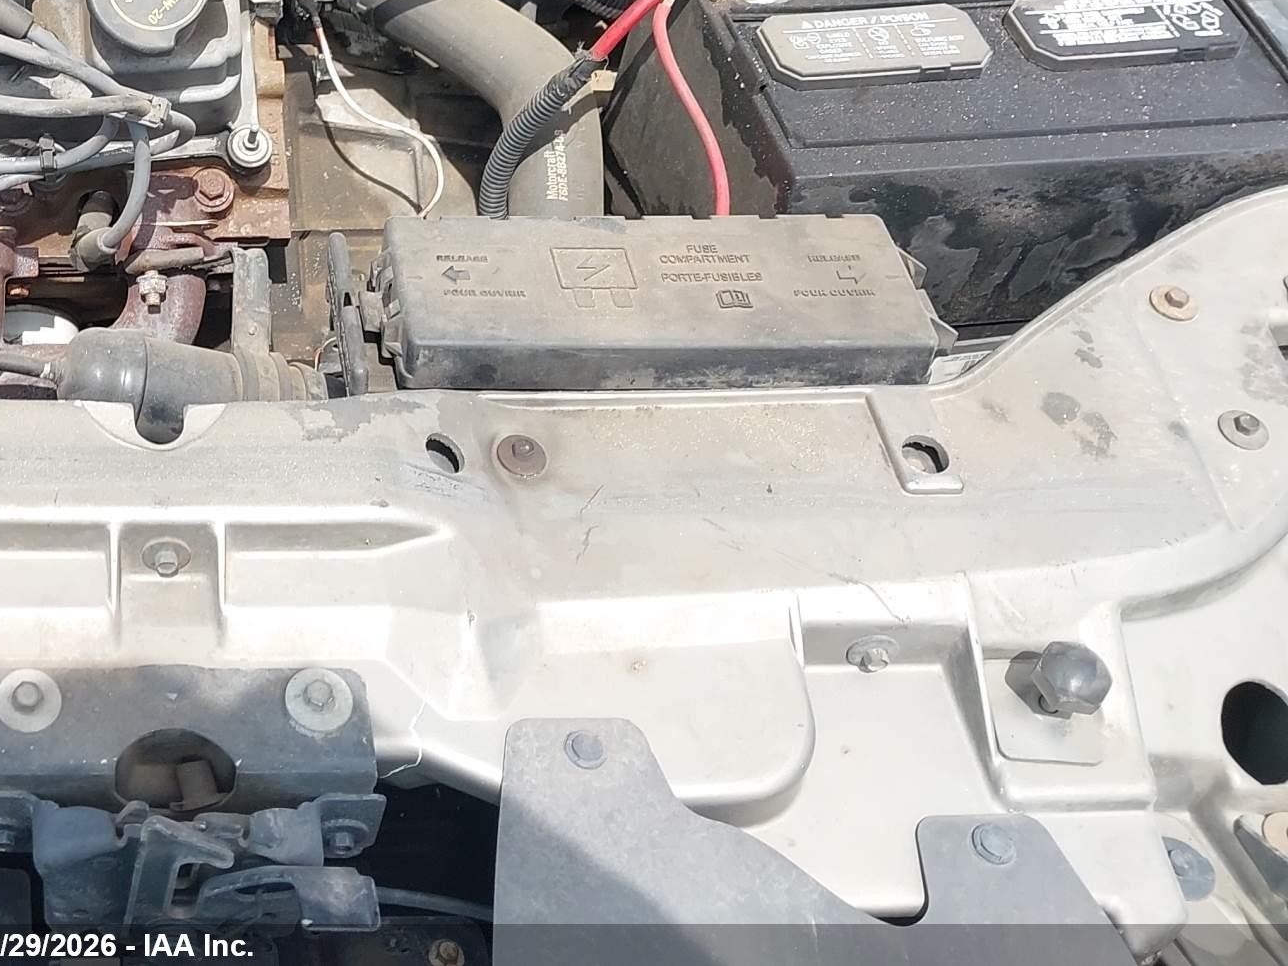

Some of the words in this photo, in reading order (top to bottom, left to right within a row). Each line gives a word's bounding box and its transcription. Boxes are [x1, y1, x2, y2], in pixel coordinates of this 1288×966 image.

[814, 16, 866, 30] DANGER
[879, 11, 930, 24] POISON
[543, 150, 559, 201] Motorcraft
[686, 244, 718, 254] FUSE
[659, 254, 751, 264] COMPARTMENT
[661, 272, 763, 283] PORTE-FUSIBLES
